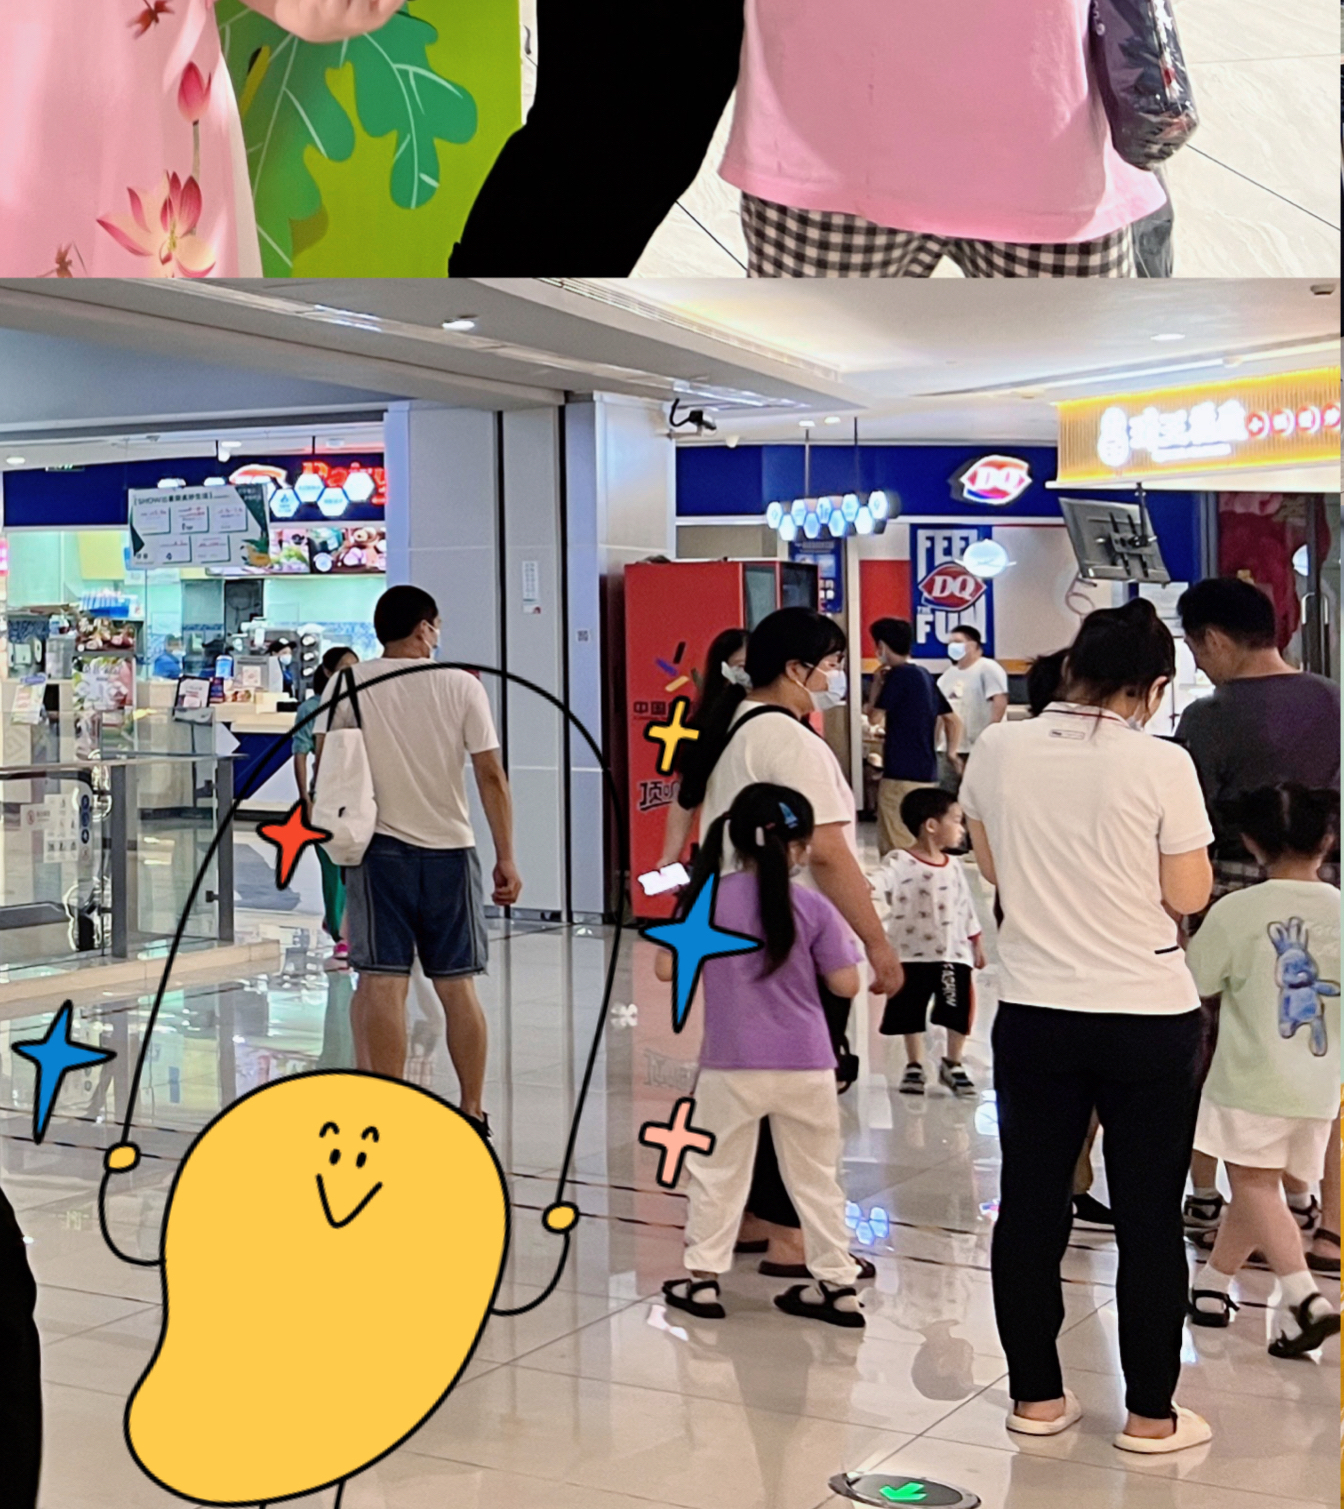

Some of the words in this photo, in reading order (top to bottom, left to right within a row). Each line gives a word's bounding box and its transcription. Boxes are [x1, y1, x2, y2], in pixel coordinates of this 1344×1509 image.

[975, 466, 1020, 490] DQ
[917, 529, 978, 583] FEE
[932, 575, 976, 600] DQ
[633, 701, 673, 715] 中国
